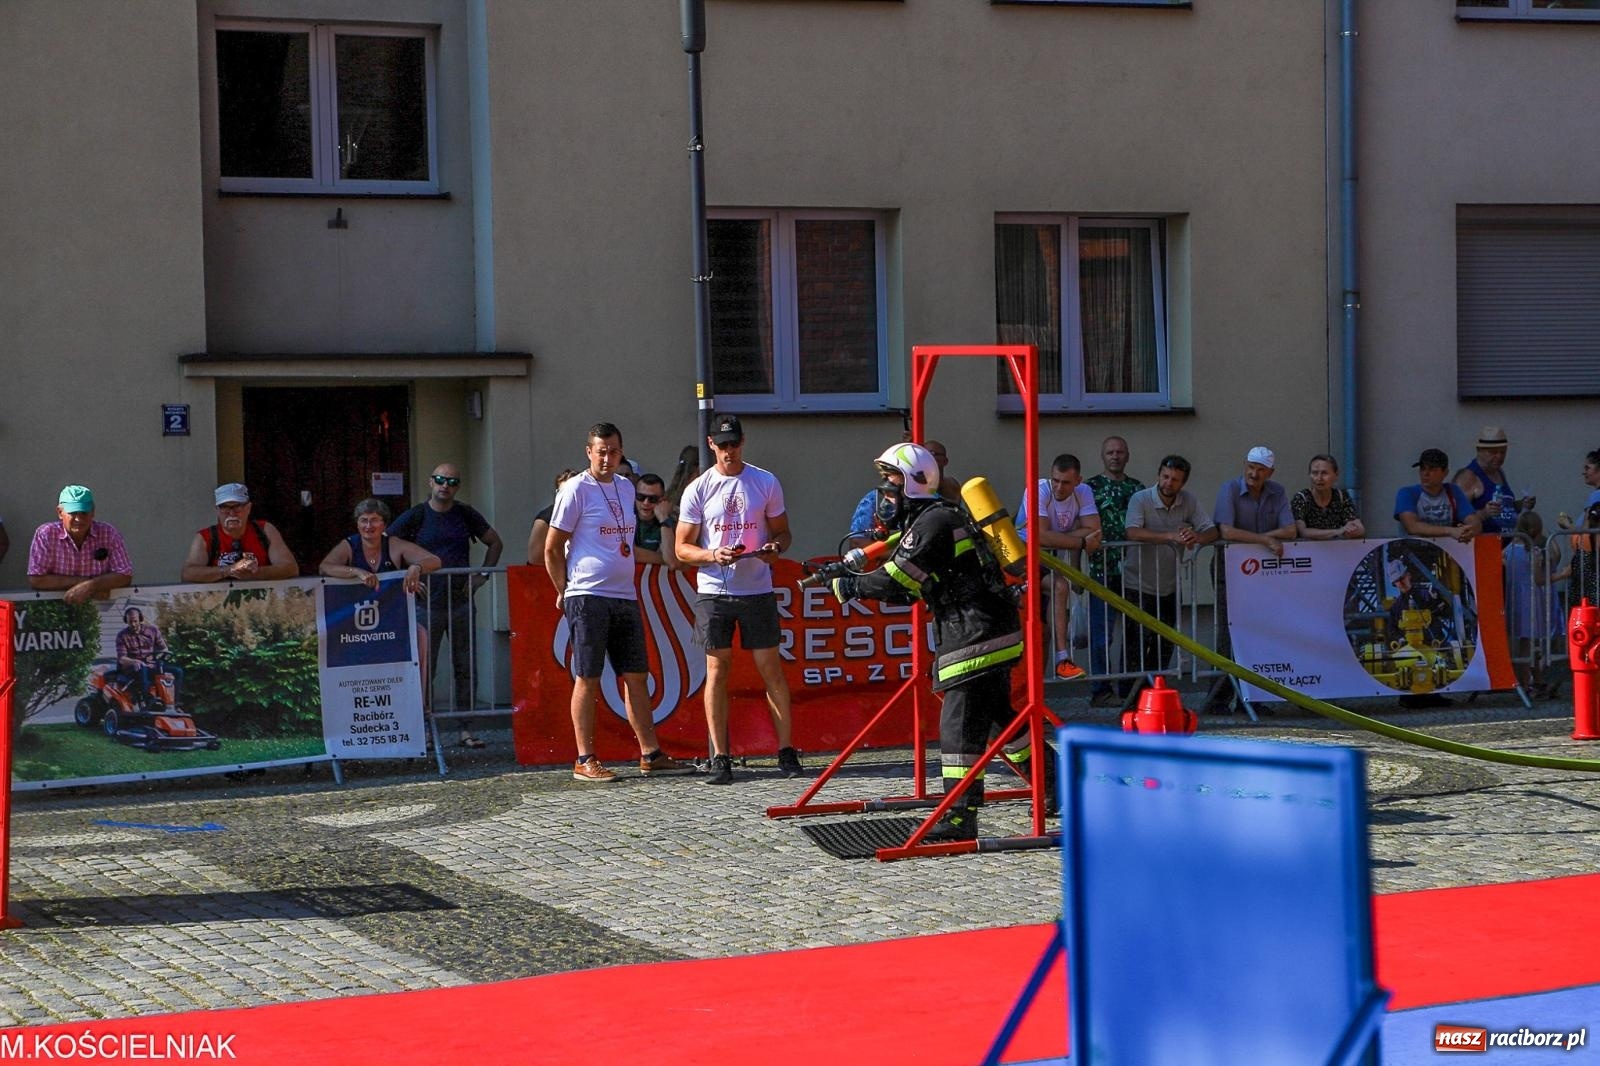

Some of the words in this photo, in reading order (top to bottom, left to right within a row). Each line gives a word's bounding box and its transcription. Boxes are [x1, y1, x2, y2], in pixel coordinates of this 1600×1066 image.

[170, 415, 182, 428] 2
[340, 631, 396, 643] Husqvarna
[804, 667, 853, 684] SP.
[868, 664, 885, 681] Z
[1252, 663, 1294, 673] SYSTEM,
[339, 678, 386, 688] AUTORYZOWANY
[387, 676, 403, 684] DILER
[1289, 675, 1322, 687] ŁĄCZY
[354, 694, 391, 709] RE-WI
[353, 711, 395, 722] Racibórz
[350, 725, 390, 734] Sudecka
[393, 722, 399, 731] 3
[342, 738, 355, 747] tel.
[357, 736, 368, 746] 32
[371, 735, 386, 745] 755
[388, 734, 397, 743] 18
[399, 733, 410, 743] 74
